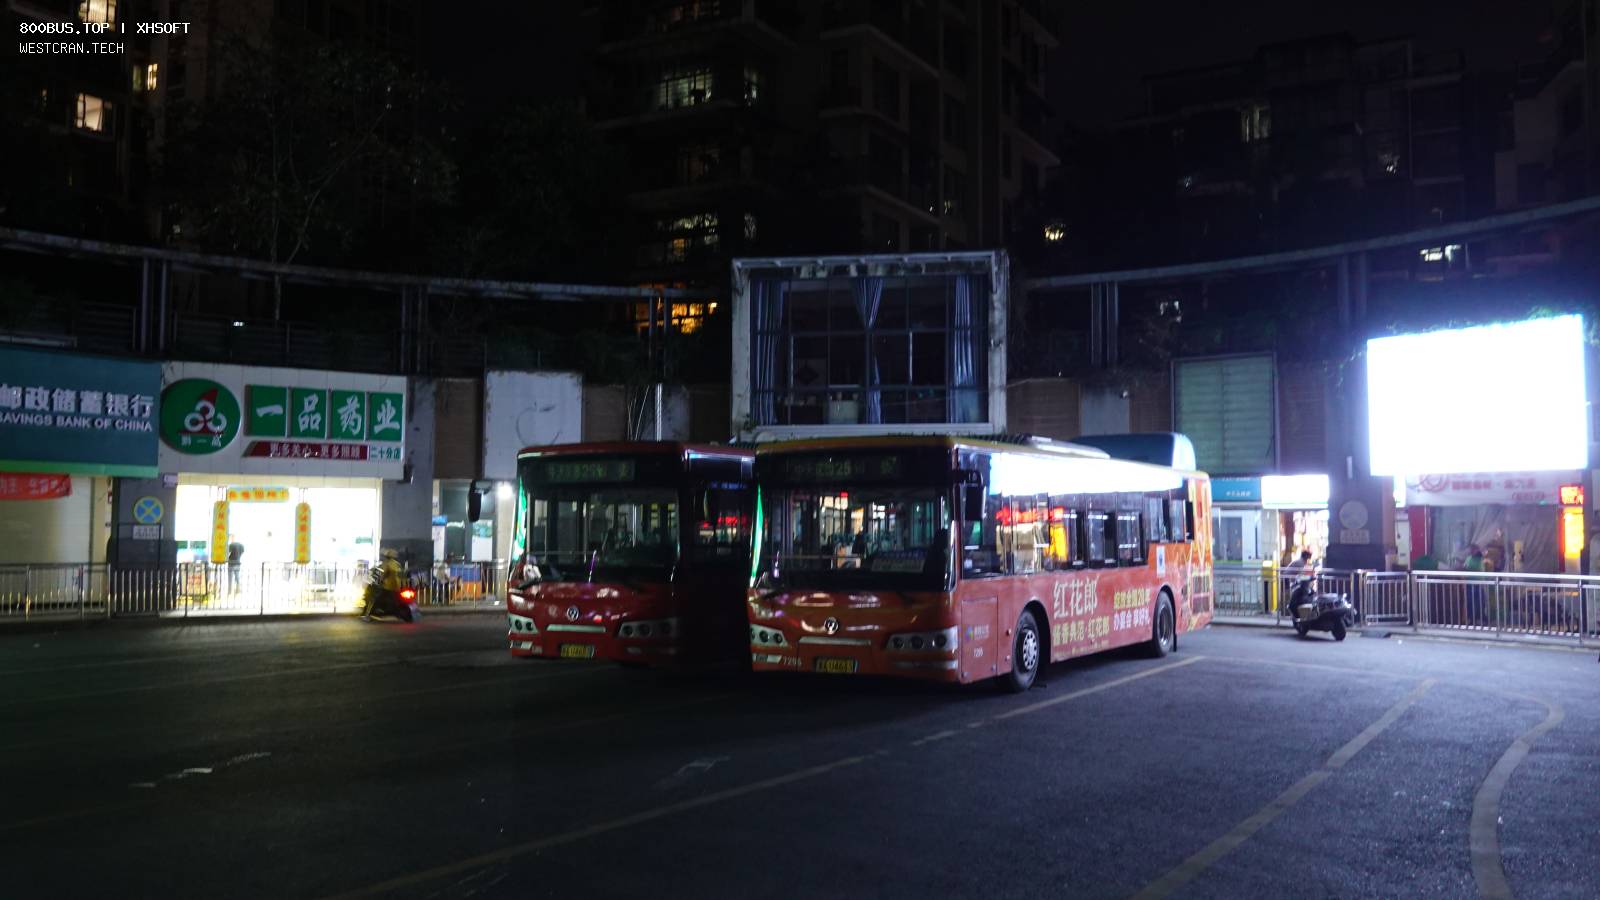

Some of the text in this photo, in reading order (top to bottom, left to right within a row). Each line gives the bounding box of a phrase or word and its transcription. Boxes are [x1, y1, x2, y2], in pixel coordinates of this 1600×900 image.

[0, 383, 154, 418] 邮政储蓄银行
[255, 392, 401, 436] 一品药业
[56, 414, 91, 428] BANK
[94, 418, 110, 429] OF
[115, 419, 153, 432] CHINA
[1053, 576, 1099, 618] 红花郎
